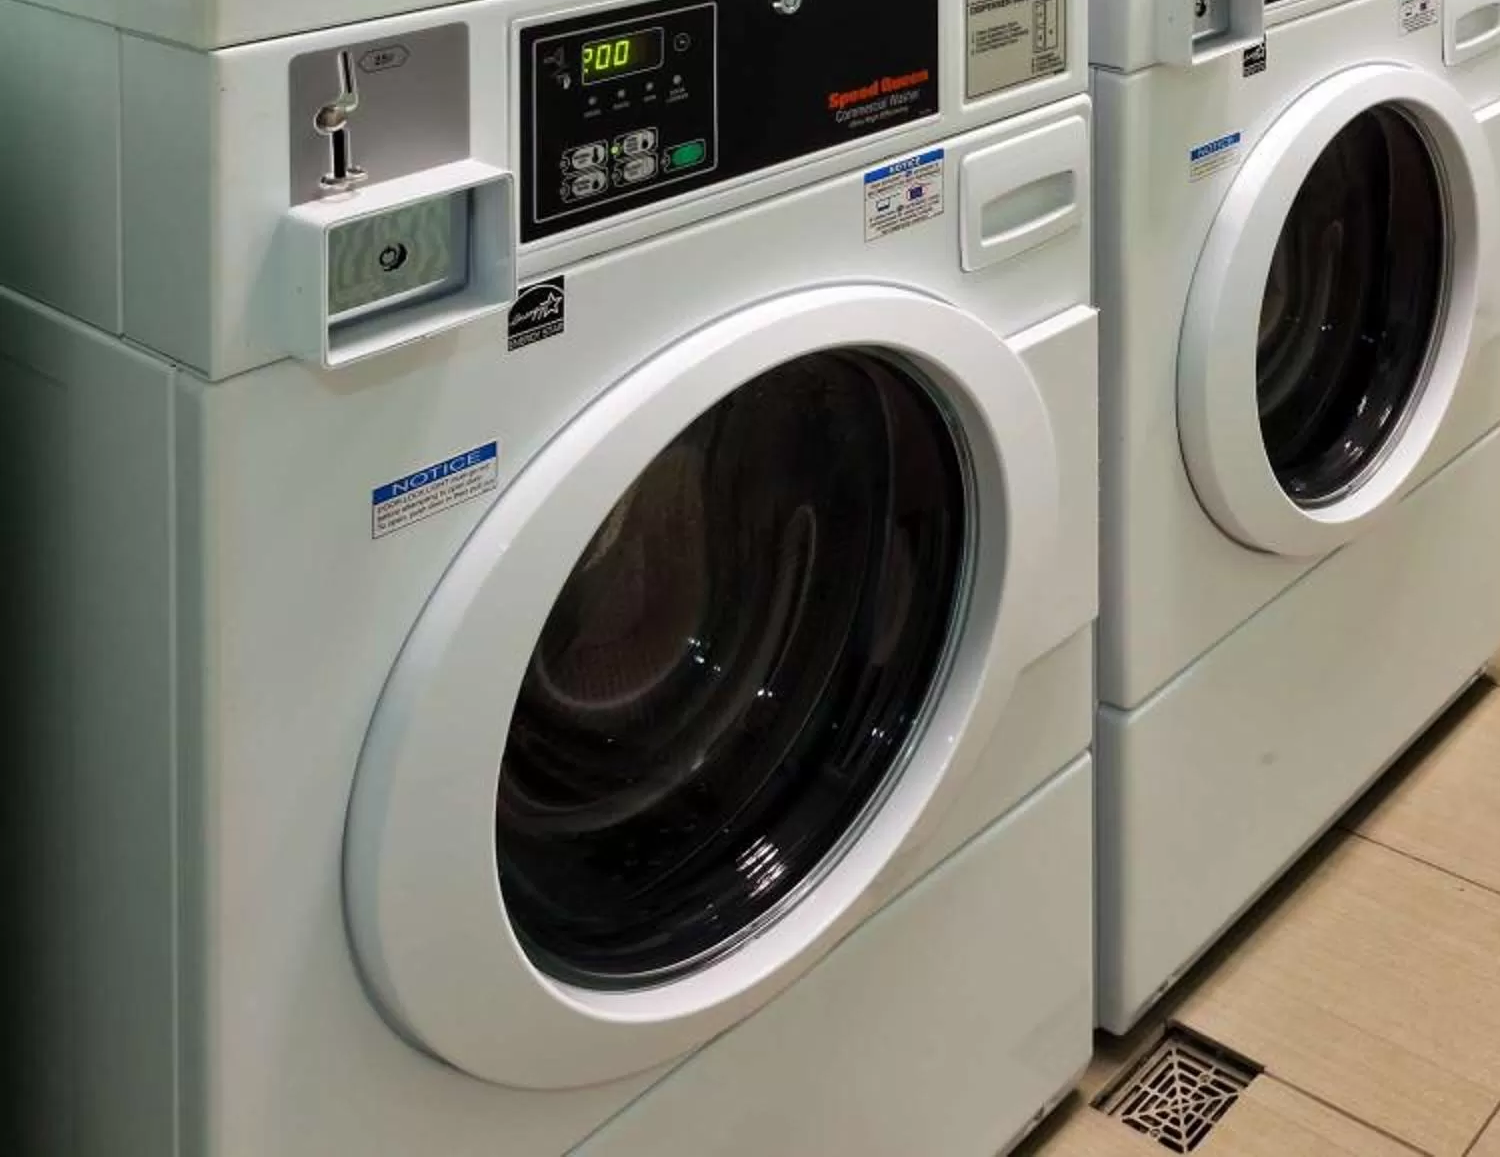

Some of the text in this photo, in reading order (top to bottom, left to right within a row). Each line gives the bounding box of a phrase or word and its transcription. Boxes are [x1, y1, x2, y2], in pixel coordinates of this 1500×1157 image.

[828, 69, 929, 111] Speed Queen
[391, 450, 481, 496] NOTICE
